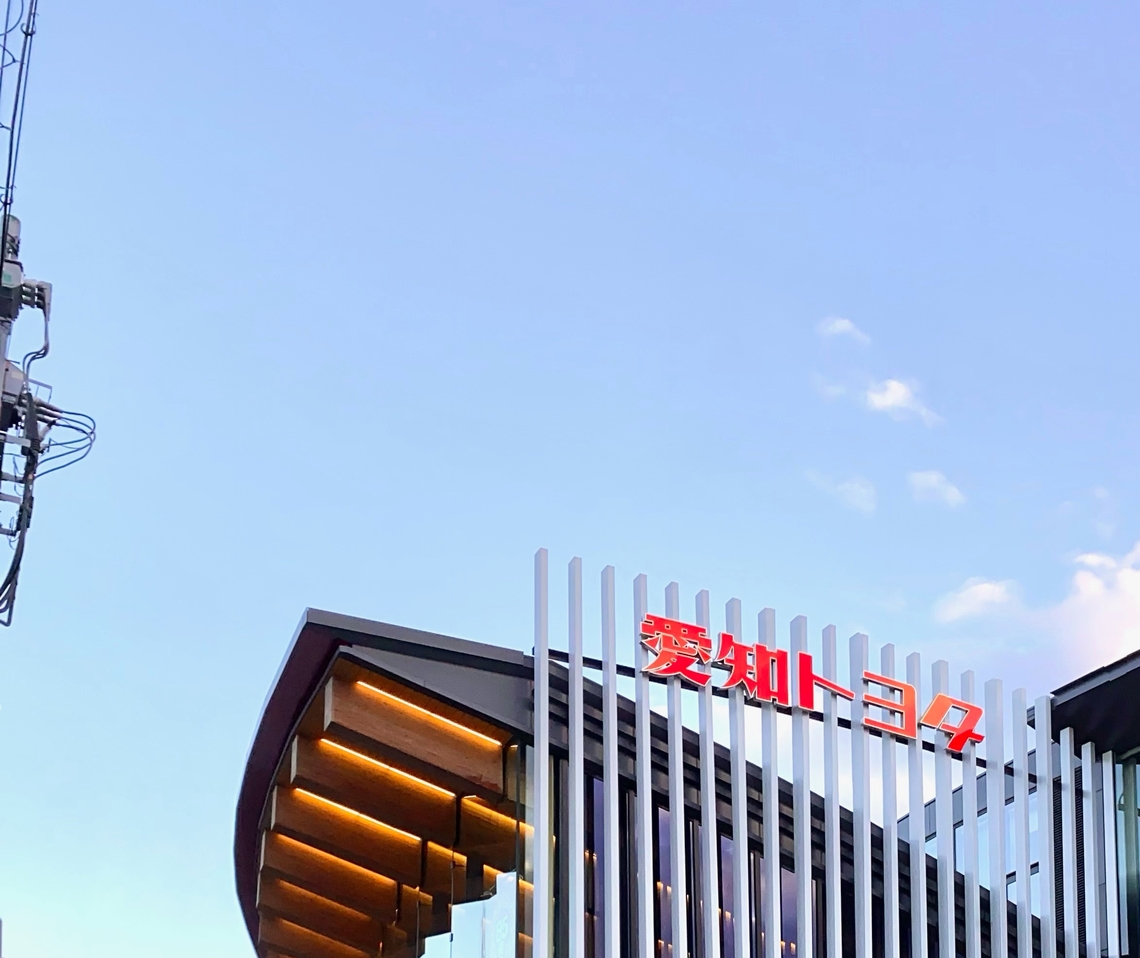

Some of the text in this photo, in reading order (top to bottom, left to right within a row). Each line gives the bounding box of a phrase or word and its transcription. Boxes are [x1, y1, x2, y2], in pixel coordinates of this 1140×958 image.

[640, 613, 984, 753] 愛知トヨタ
